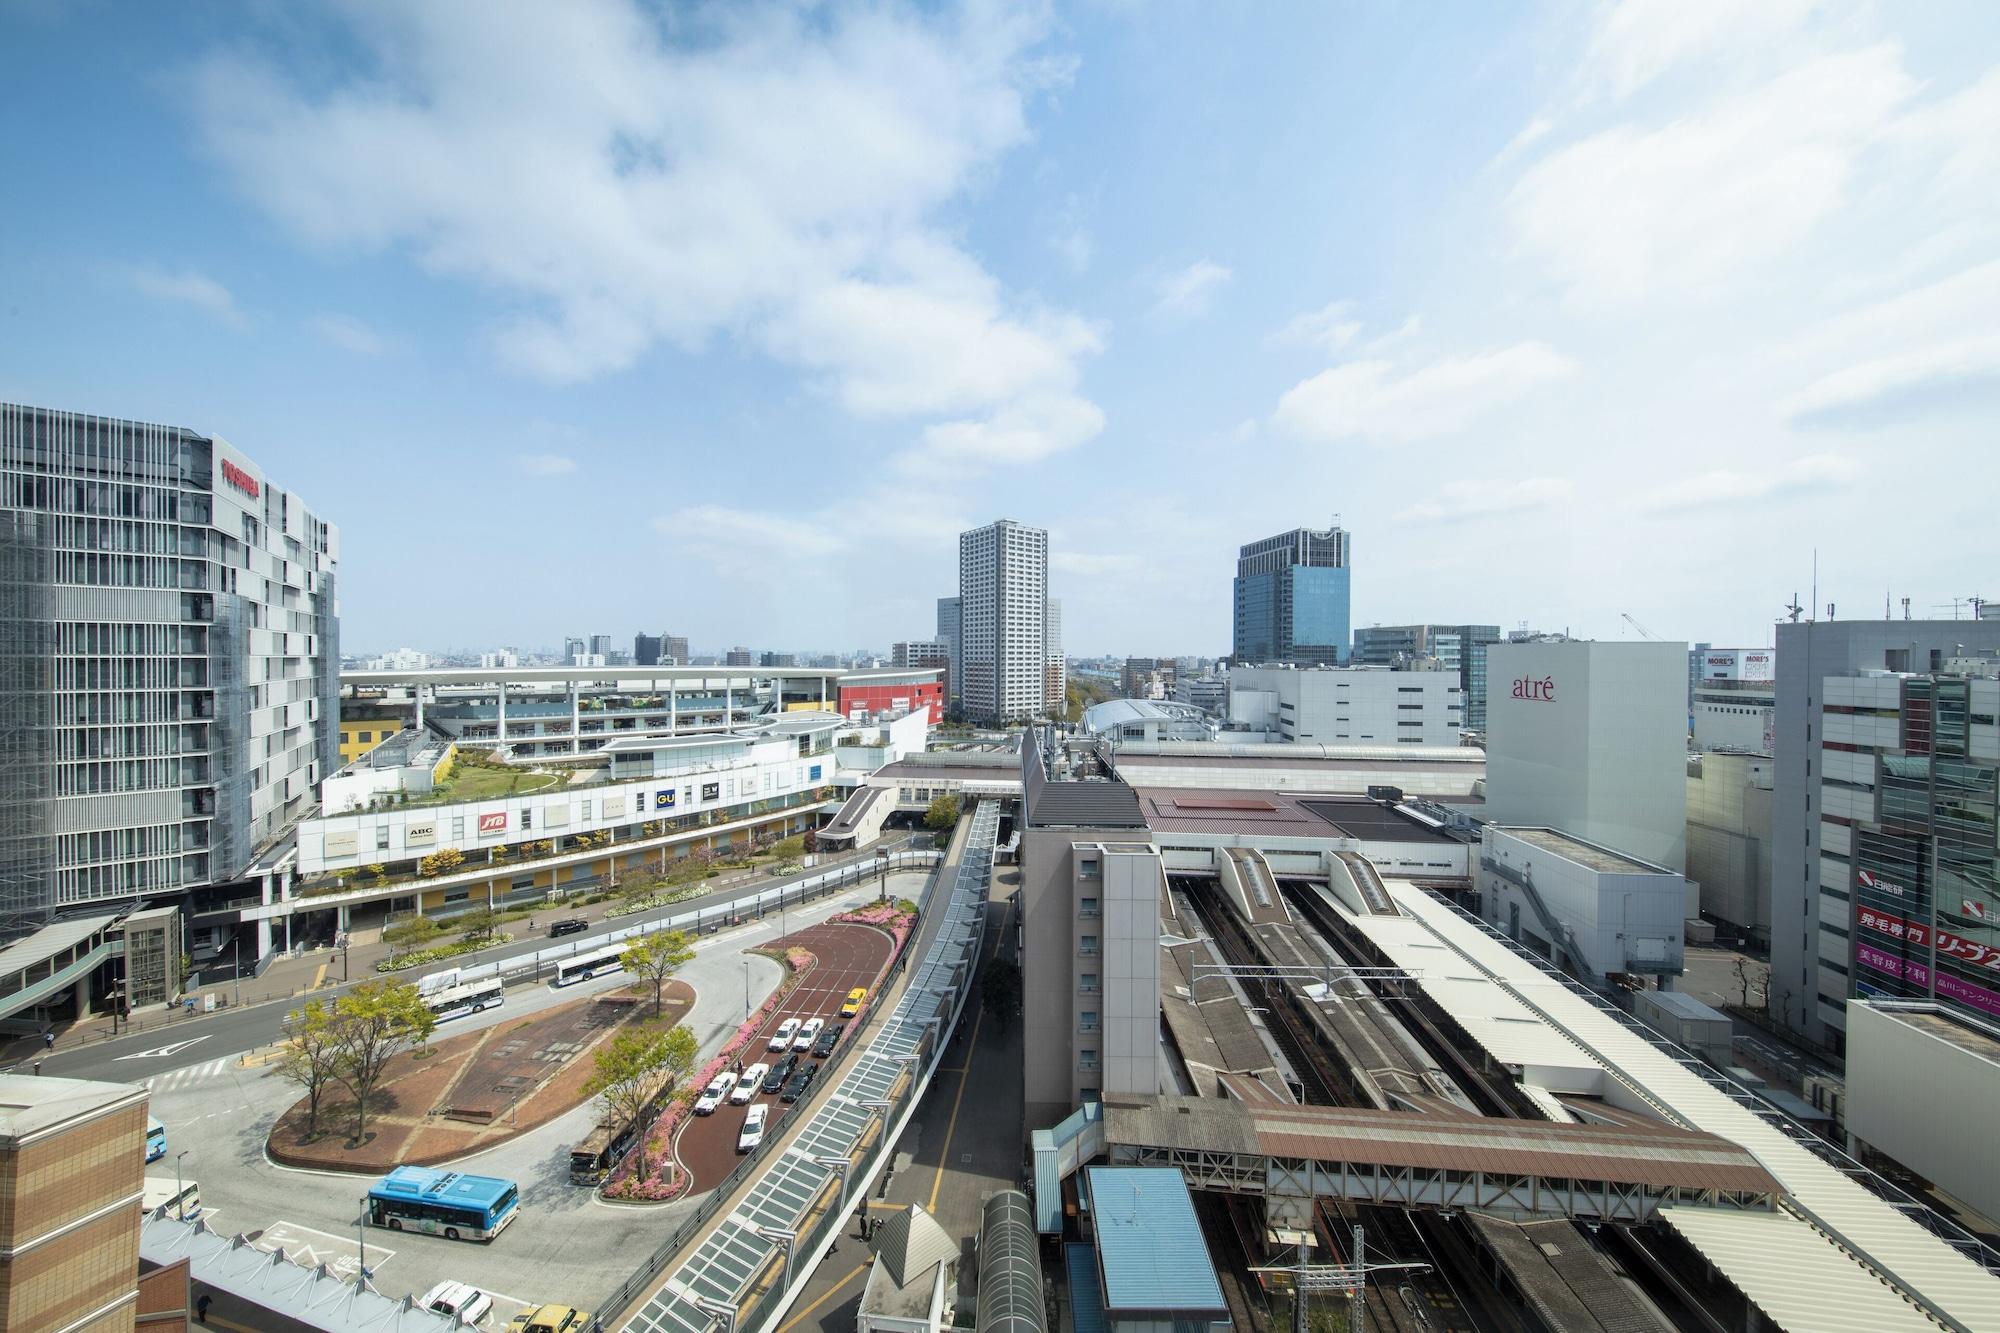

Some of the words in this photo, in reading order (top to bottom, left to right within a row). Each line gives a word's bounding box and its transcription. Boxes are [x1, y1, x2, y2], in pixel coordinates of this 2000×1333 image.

[221, 458, 260, 498] TOSHIBA
[1707, 657, 1734, 665] MORE'S
[1512, 674, 1554, 700] atré
[657, 794, 675, 804] GU
[481, 815, 505, 829] JTB
[409, 827, 433, 836] ABC
[1873, 878, 1904, 897] 日能研
[1860, 912, 1924, 942] 発毛専門
